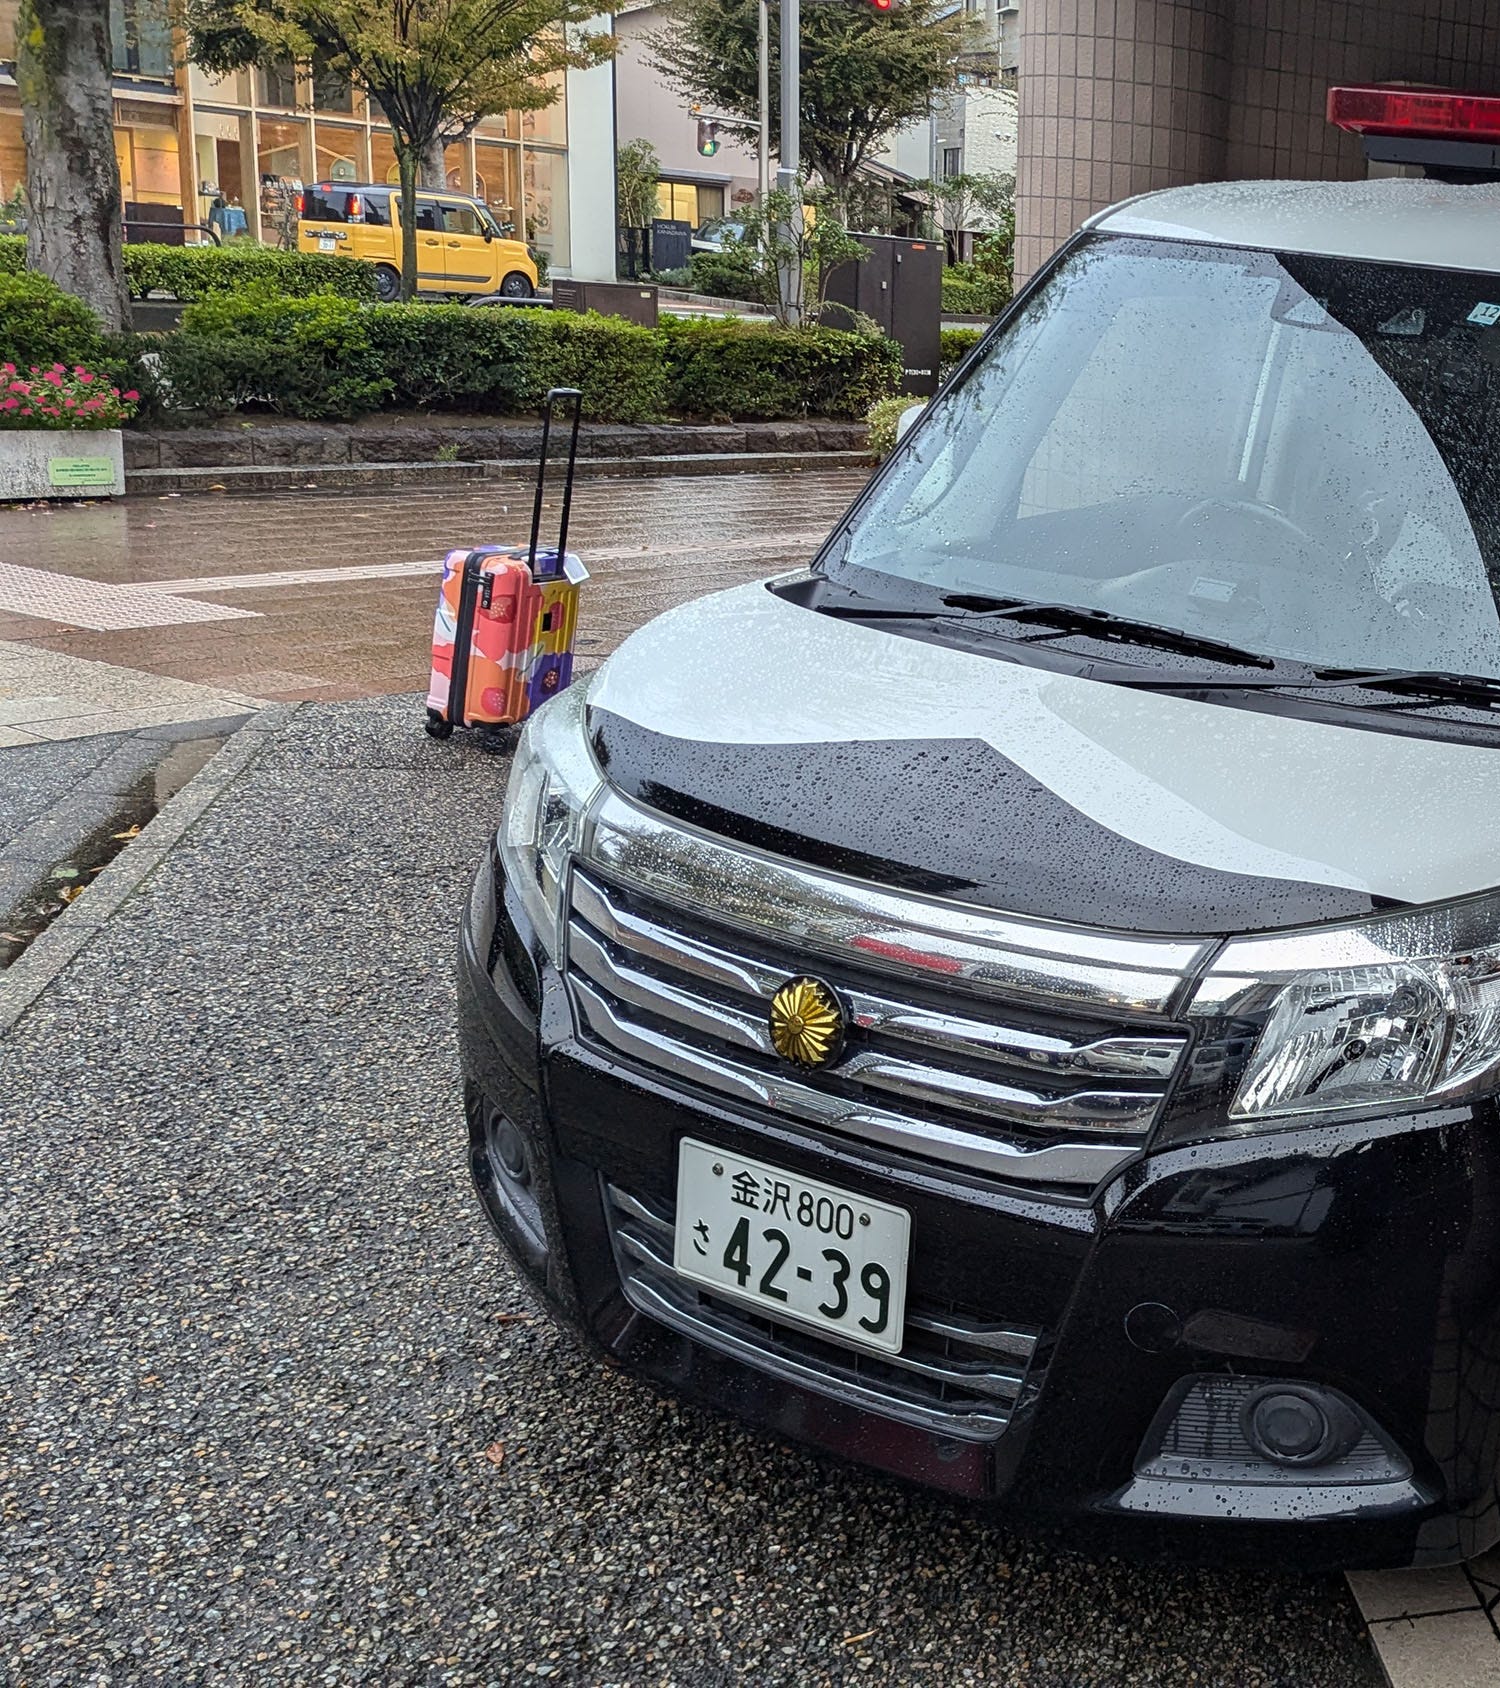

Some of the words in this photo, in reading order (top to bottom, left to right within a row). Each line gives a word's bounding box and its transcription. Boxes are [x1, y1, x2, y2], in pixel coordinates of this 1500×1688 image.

[1480, 306, 1500, 319] 12
[692, 1218, 711, 1256] さ
[723, 1215, 891, 1334] 42-39
